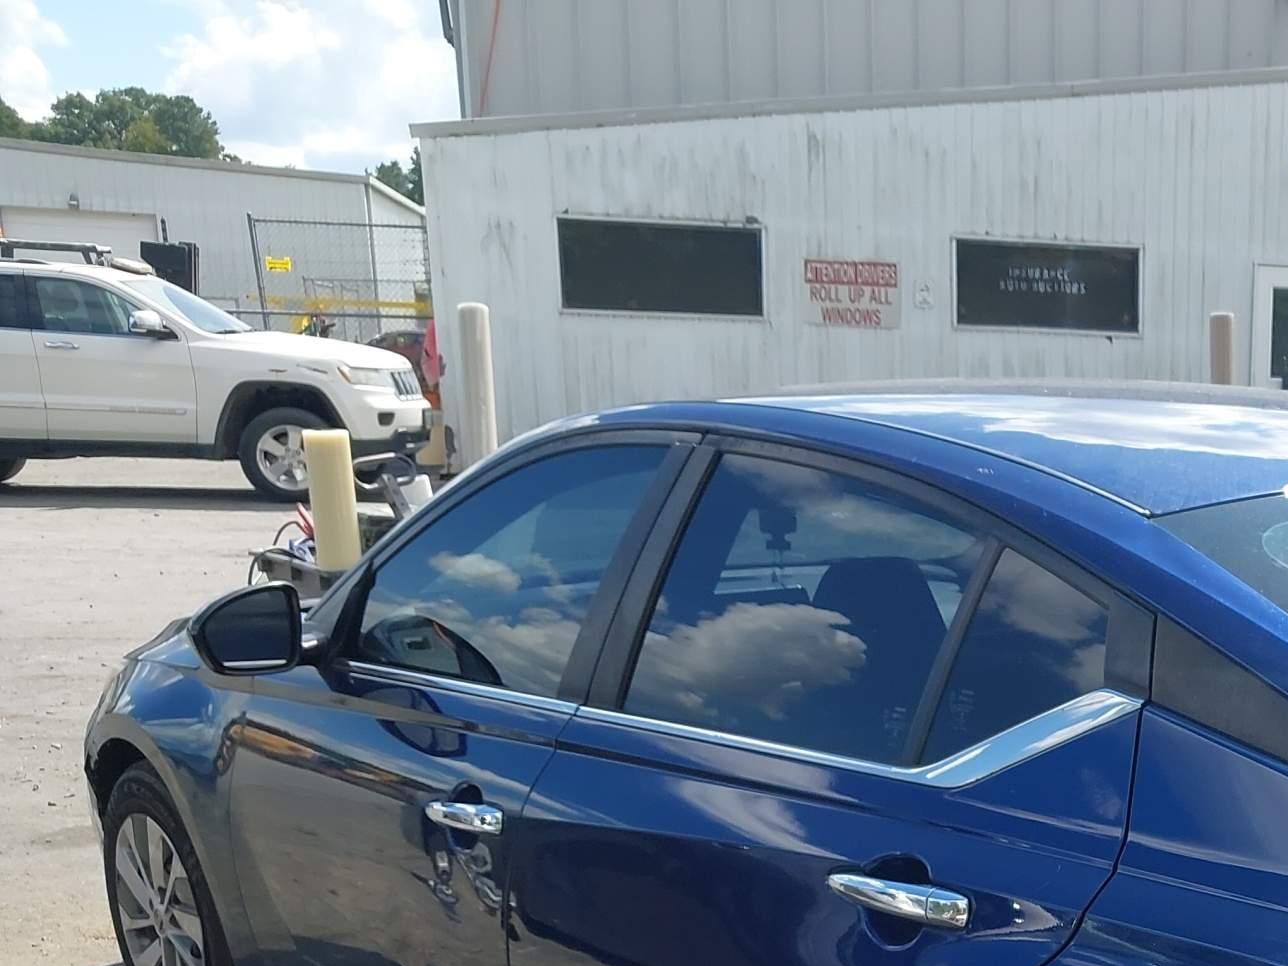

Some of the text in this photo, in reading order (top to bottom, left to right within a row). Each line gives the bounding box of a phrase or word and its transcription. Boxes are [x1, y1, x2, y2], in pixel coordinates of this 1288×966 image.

[806, 262, 896, 285] ATTENTION DRIVERS
[810, 285, 893, 305] ROLL UP ALL
[821, 307, 881, 325] WINDOWS
